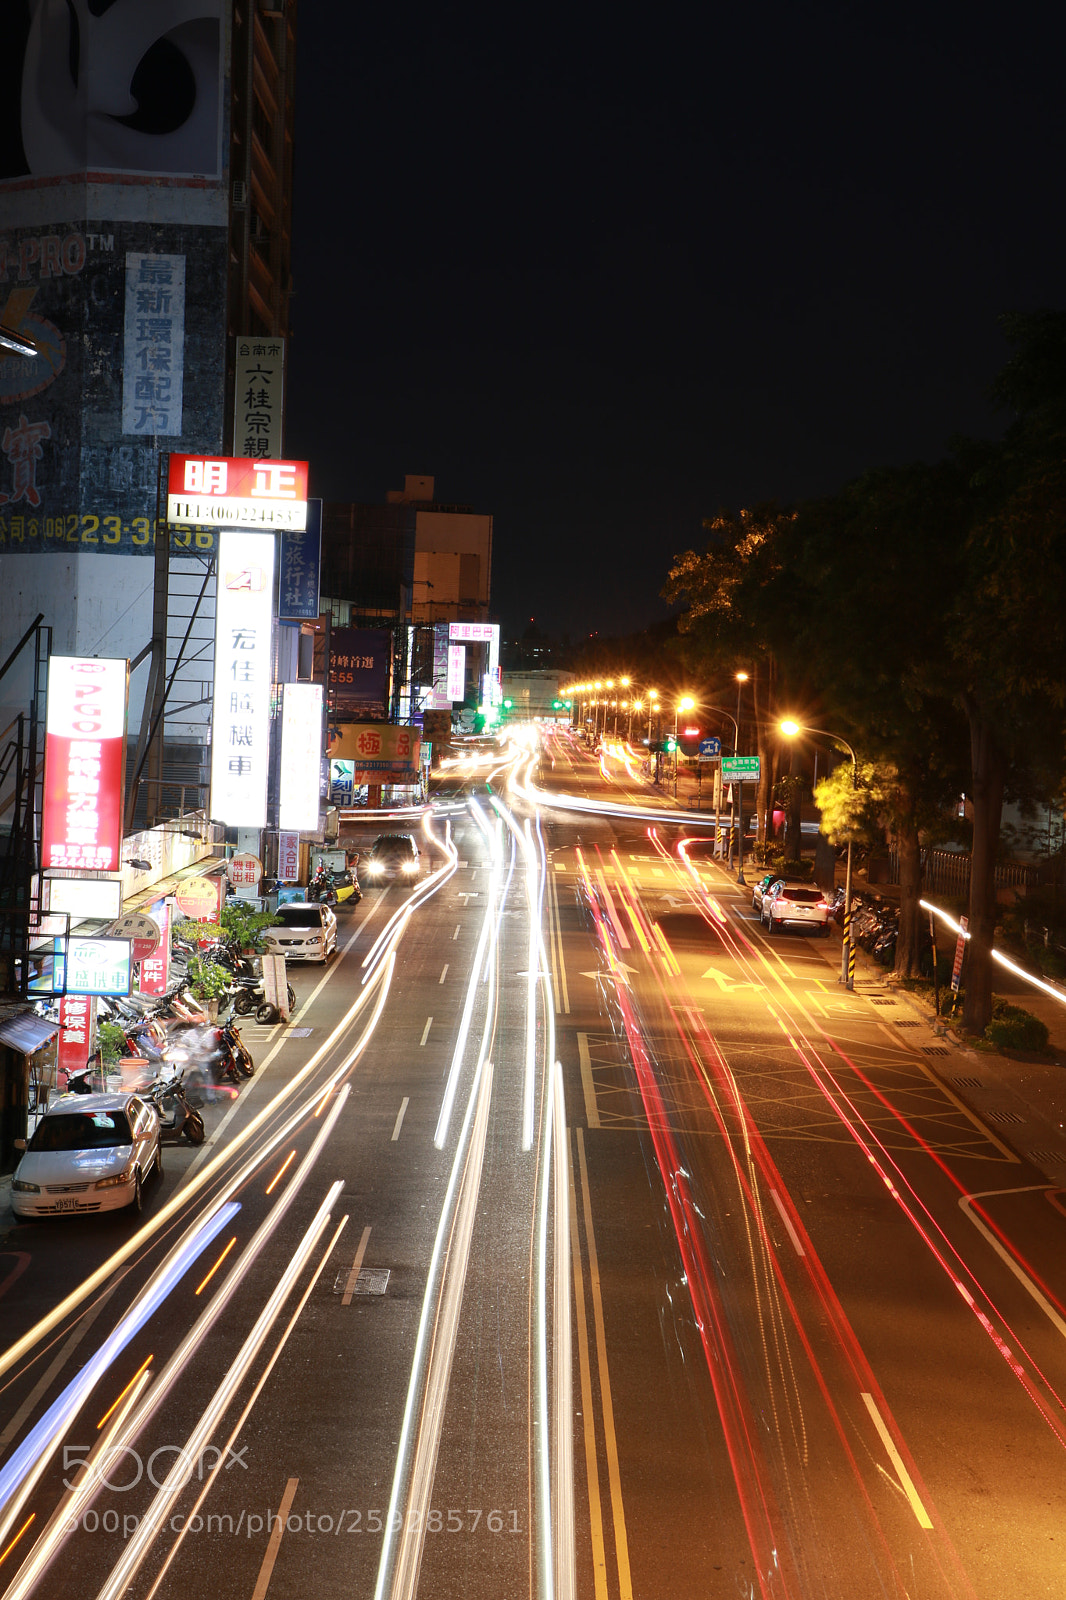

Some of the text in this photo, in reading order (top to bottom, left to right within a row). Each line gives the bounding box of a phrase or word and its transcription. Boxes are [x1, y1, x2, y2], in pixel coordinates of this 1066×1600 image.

[134, 259, 173, 430] 最新環保配方
[239, 344, 280, 356] 台南市
[243, 364, 273, 458] 六桂宗親
[184, 460, 297, 498] 明正
[450, 625, 493, 638] 阿里巴巴
[72, 684, 103, 733] PGO
[331, 780, 352, 806] 刻印
[50, 857, 112, 869] 2244537
[233, 860, 256, 871] 機車
[285, 835, 297, 879] 家合旺
[232, 871, 255, 883] 出租
[143, 960, 163, 982] 配件
